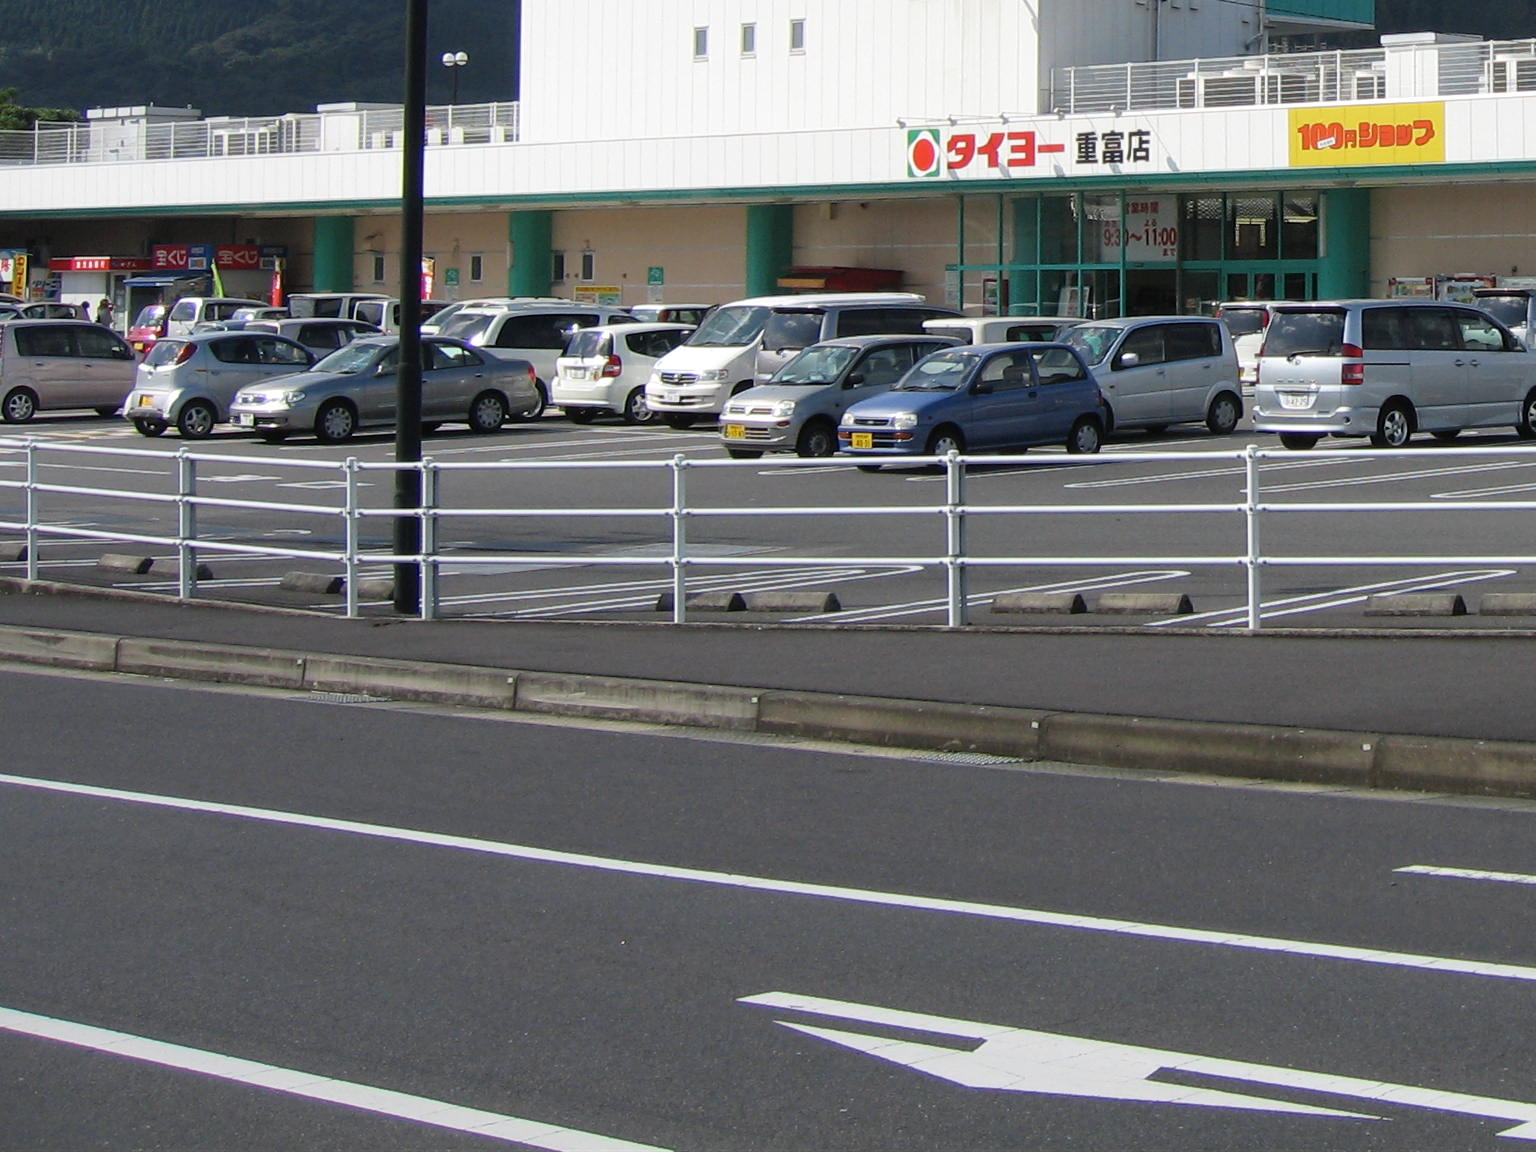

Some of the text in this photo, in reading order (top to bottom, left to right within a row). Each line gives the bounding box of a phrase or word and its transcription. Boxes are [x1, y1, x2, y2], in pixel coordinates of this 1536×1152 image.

[946, 129, 1151, 170] タイヨー 重富店
